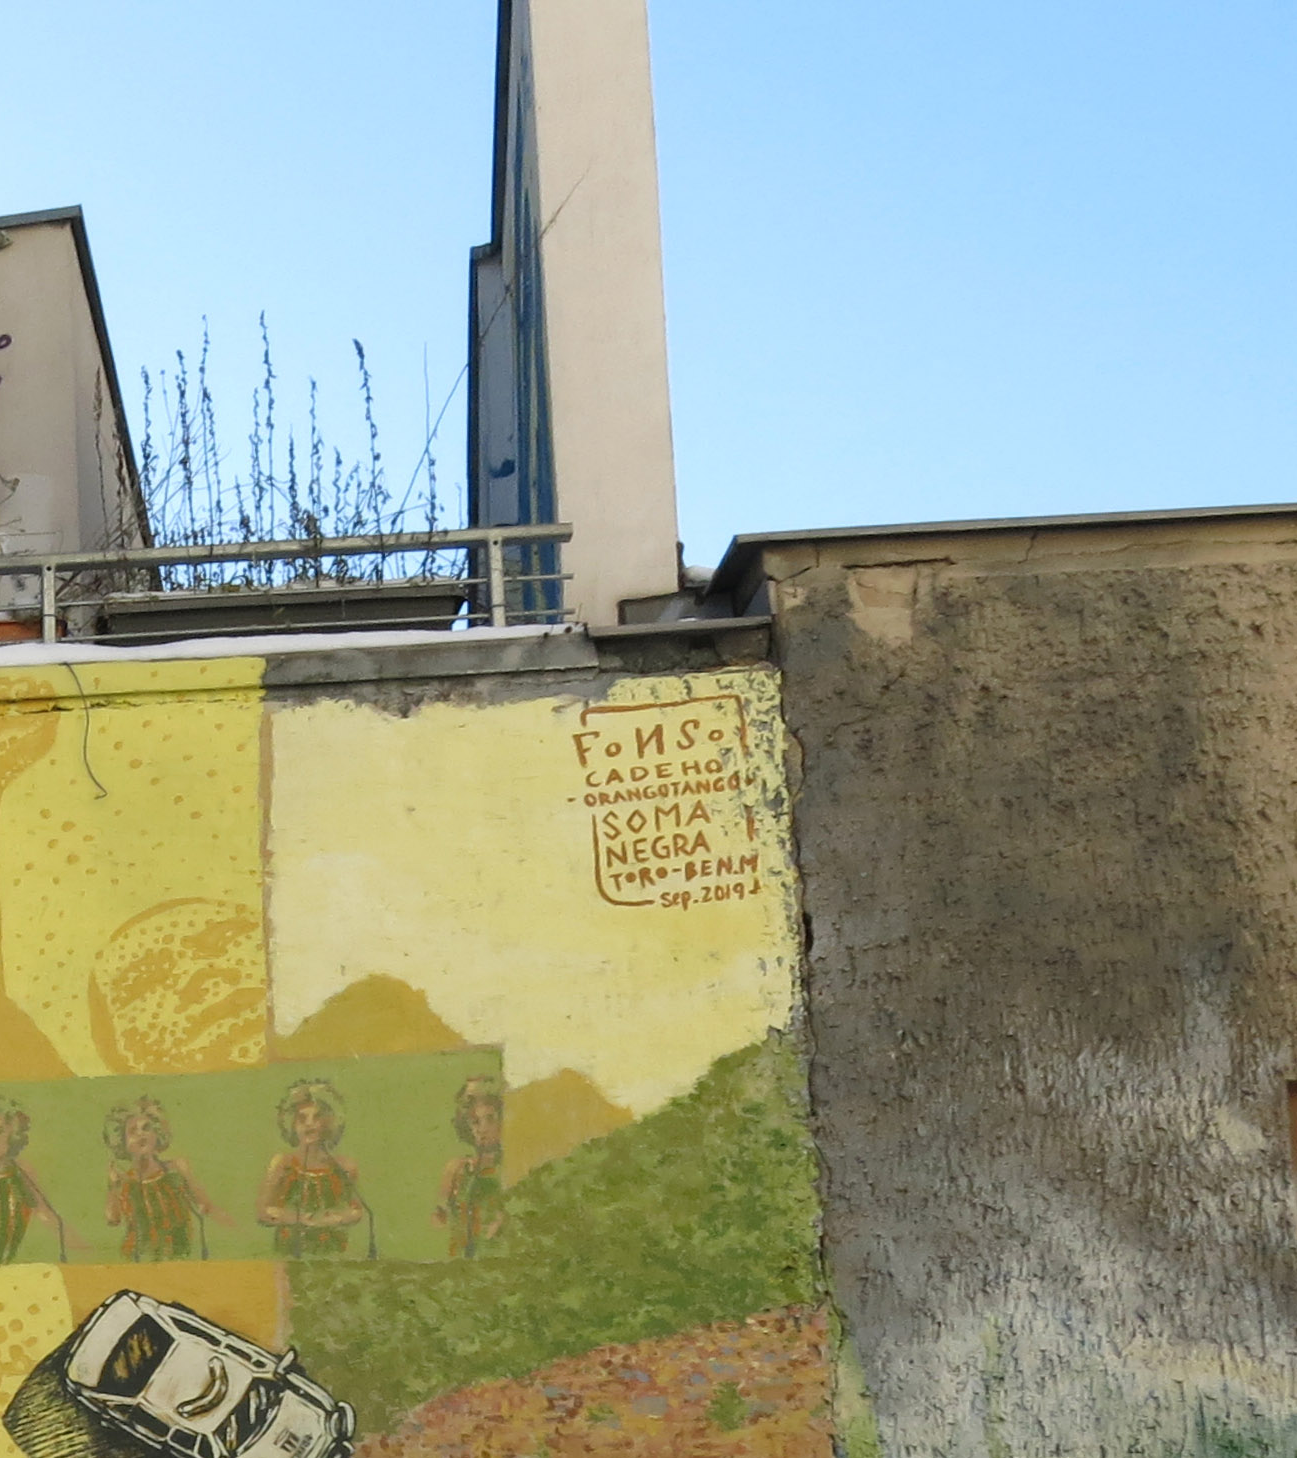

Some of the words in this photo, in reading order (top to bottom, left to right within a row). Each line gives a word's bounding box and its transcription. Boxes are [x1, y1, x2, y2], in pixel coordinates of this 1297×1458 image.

[585, 759, 723, 788] CADEHO
[602, 800, 711, 840] SOMA
[606, 830, 711, 868] NEGRA
